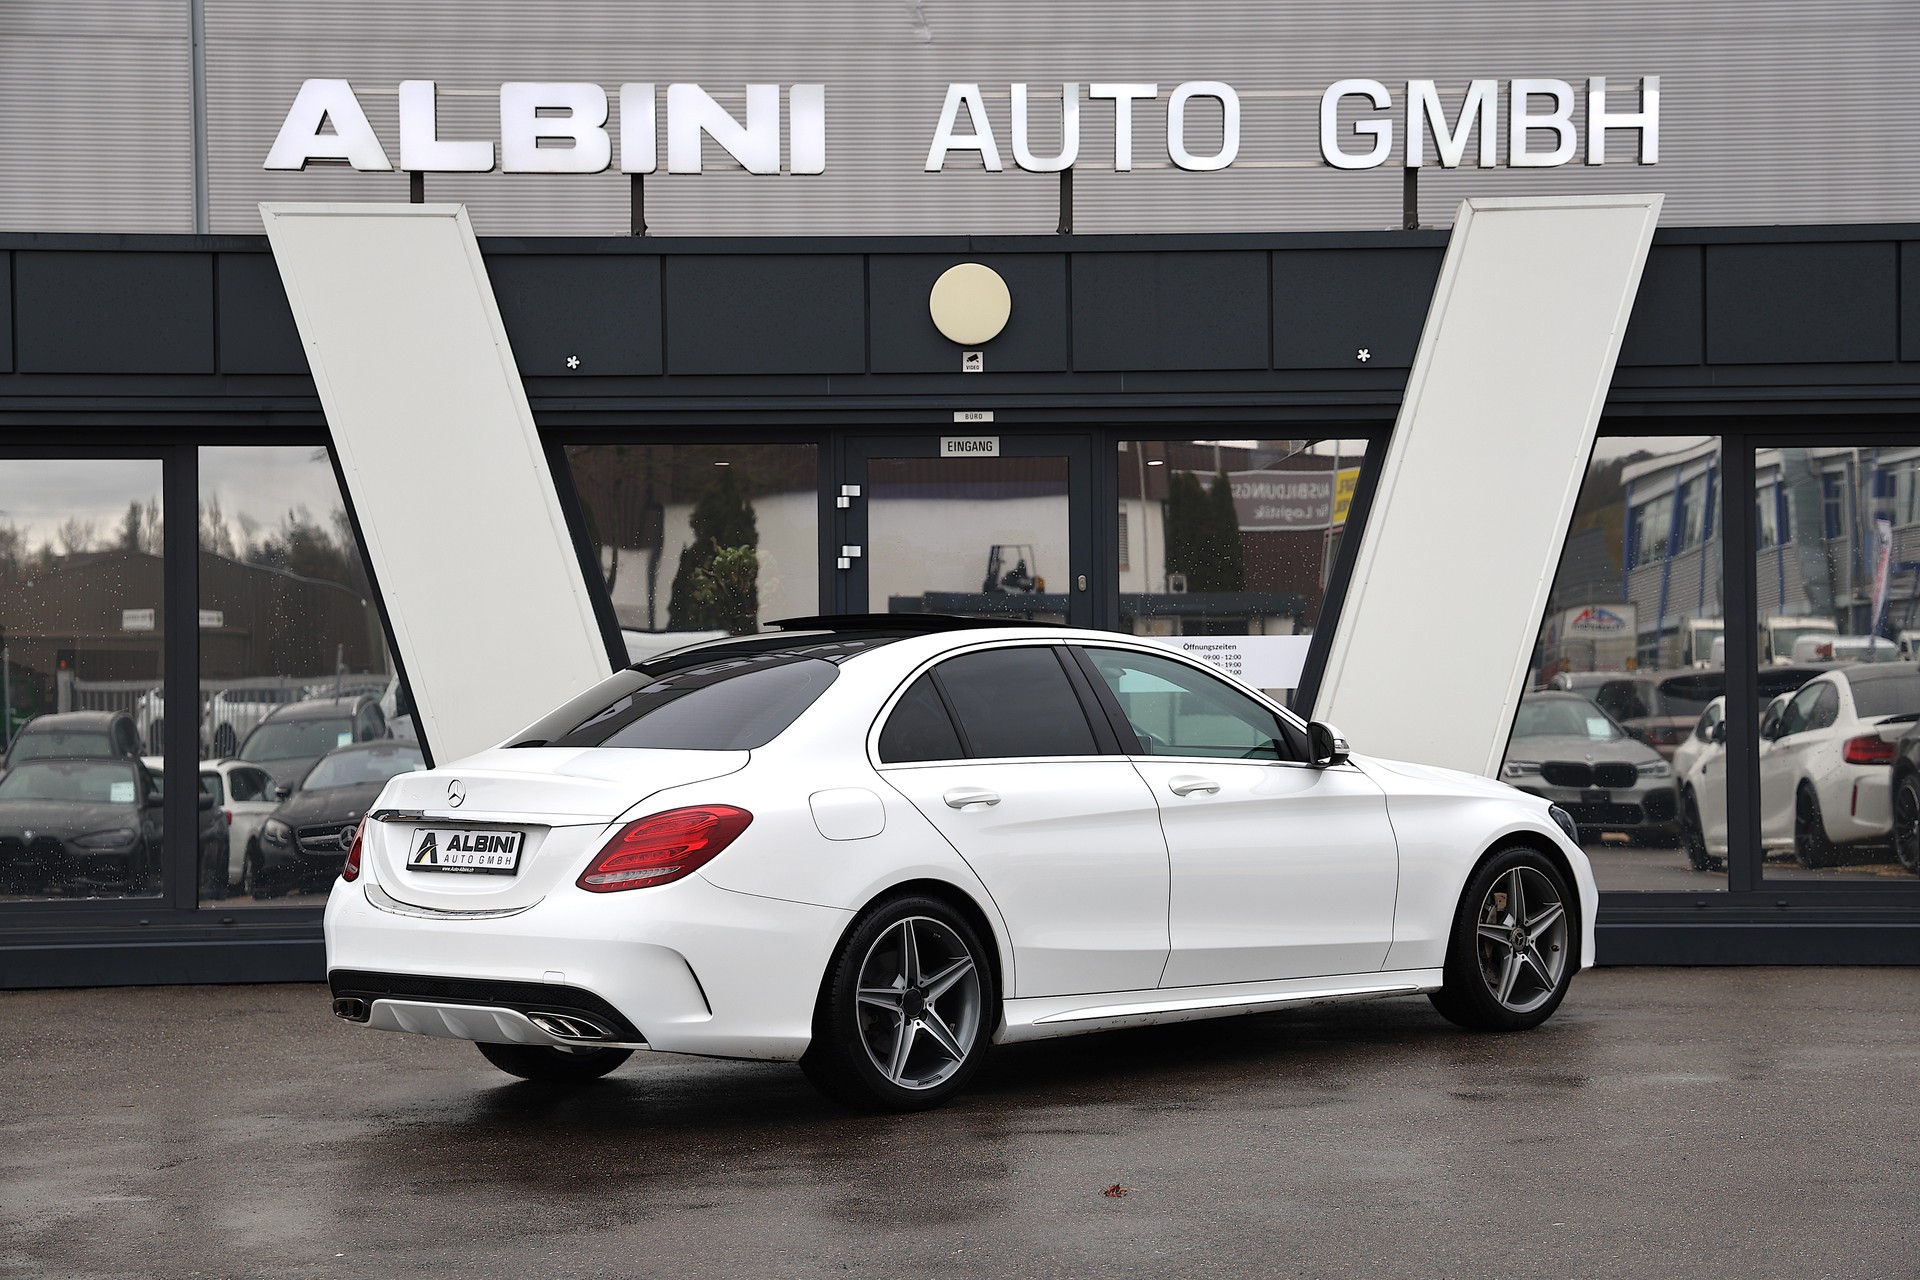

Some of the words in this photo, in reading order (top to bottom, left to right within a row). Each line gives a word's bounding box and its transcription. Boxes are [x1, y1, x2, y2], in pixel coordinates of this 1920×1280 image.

[263, 78, 825, 175] ALBINI
[924, 80, 1241, 173] AUTO
[1318, 75, 1660, 169] GMBH
[947, 441, 993, 452] EINGANG
[1183, 643, 1237, 651] Öffnungszeiten
[446, 835, 515, 853] ALBINI
[444, 854, 473, 863] AUTO
[478, 855, 512, 865] GMBH
